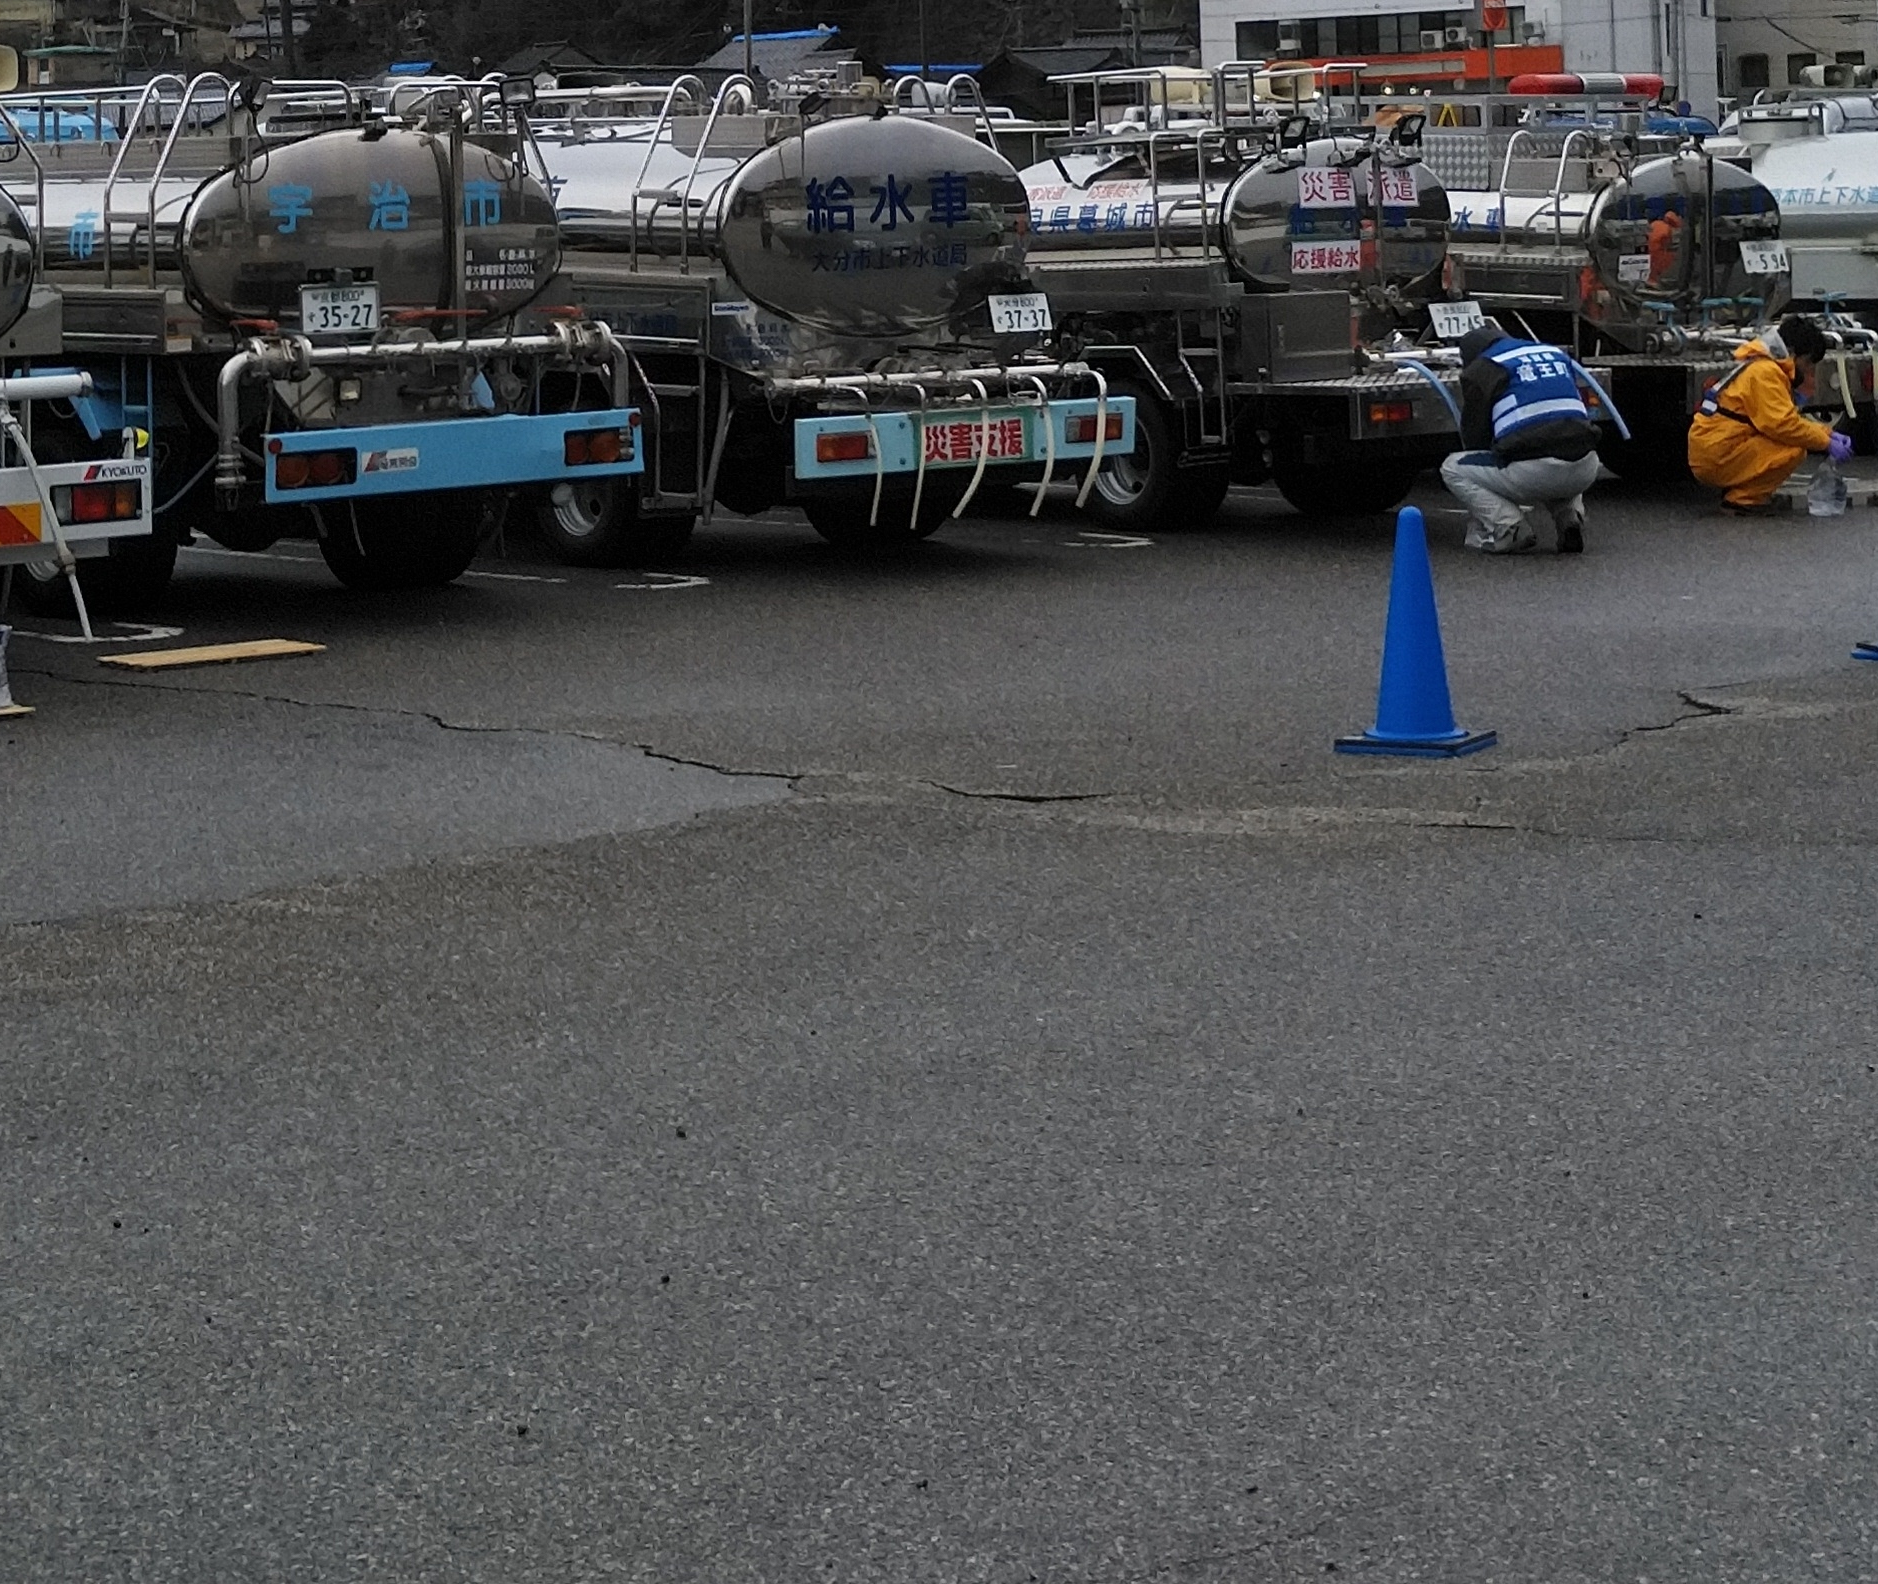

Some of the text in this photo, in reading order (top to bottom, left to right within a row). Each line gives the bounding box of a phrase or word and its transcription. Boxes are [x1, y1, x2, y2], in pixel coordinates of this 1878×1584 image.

[1301, 168, 1417, 202] 災害 派遣
[267, 179, 501, 234] 宇治市
[806, 171, 969, 234] 給水車
[812, 243, 967, 273] 大分市上下水道局
[1292, 247, 1360, 271] 応援給水
[319, 304, 373, 328] 35-27
[1005, 308, 1046, 329] 37-37
[924, 418, 1023, 464] 災害支援
[101, 465, 148, 478] KYOKUTO
